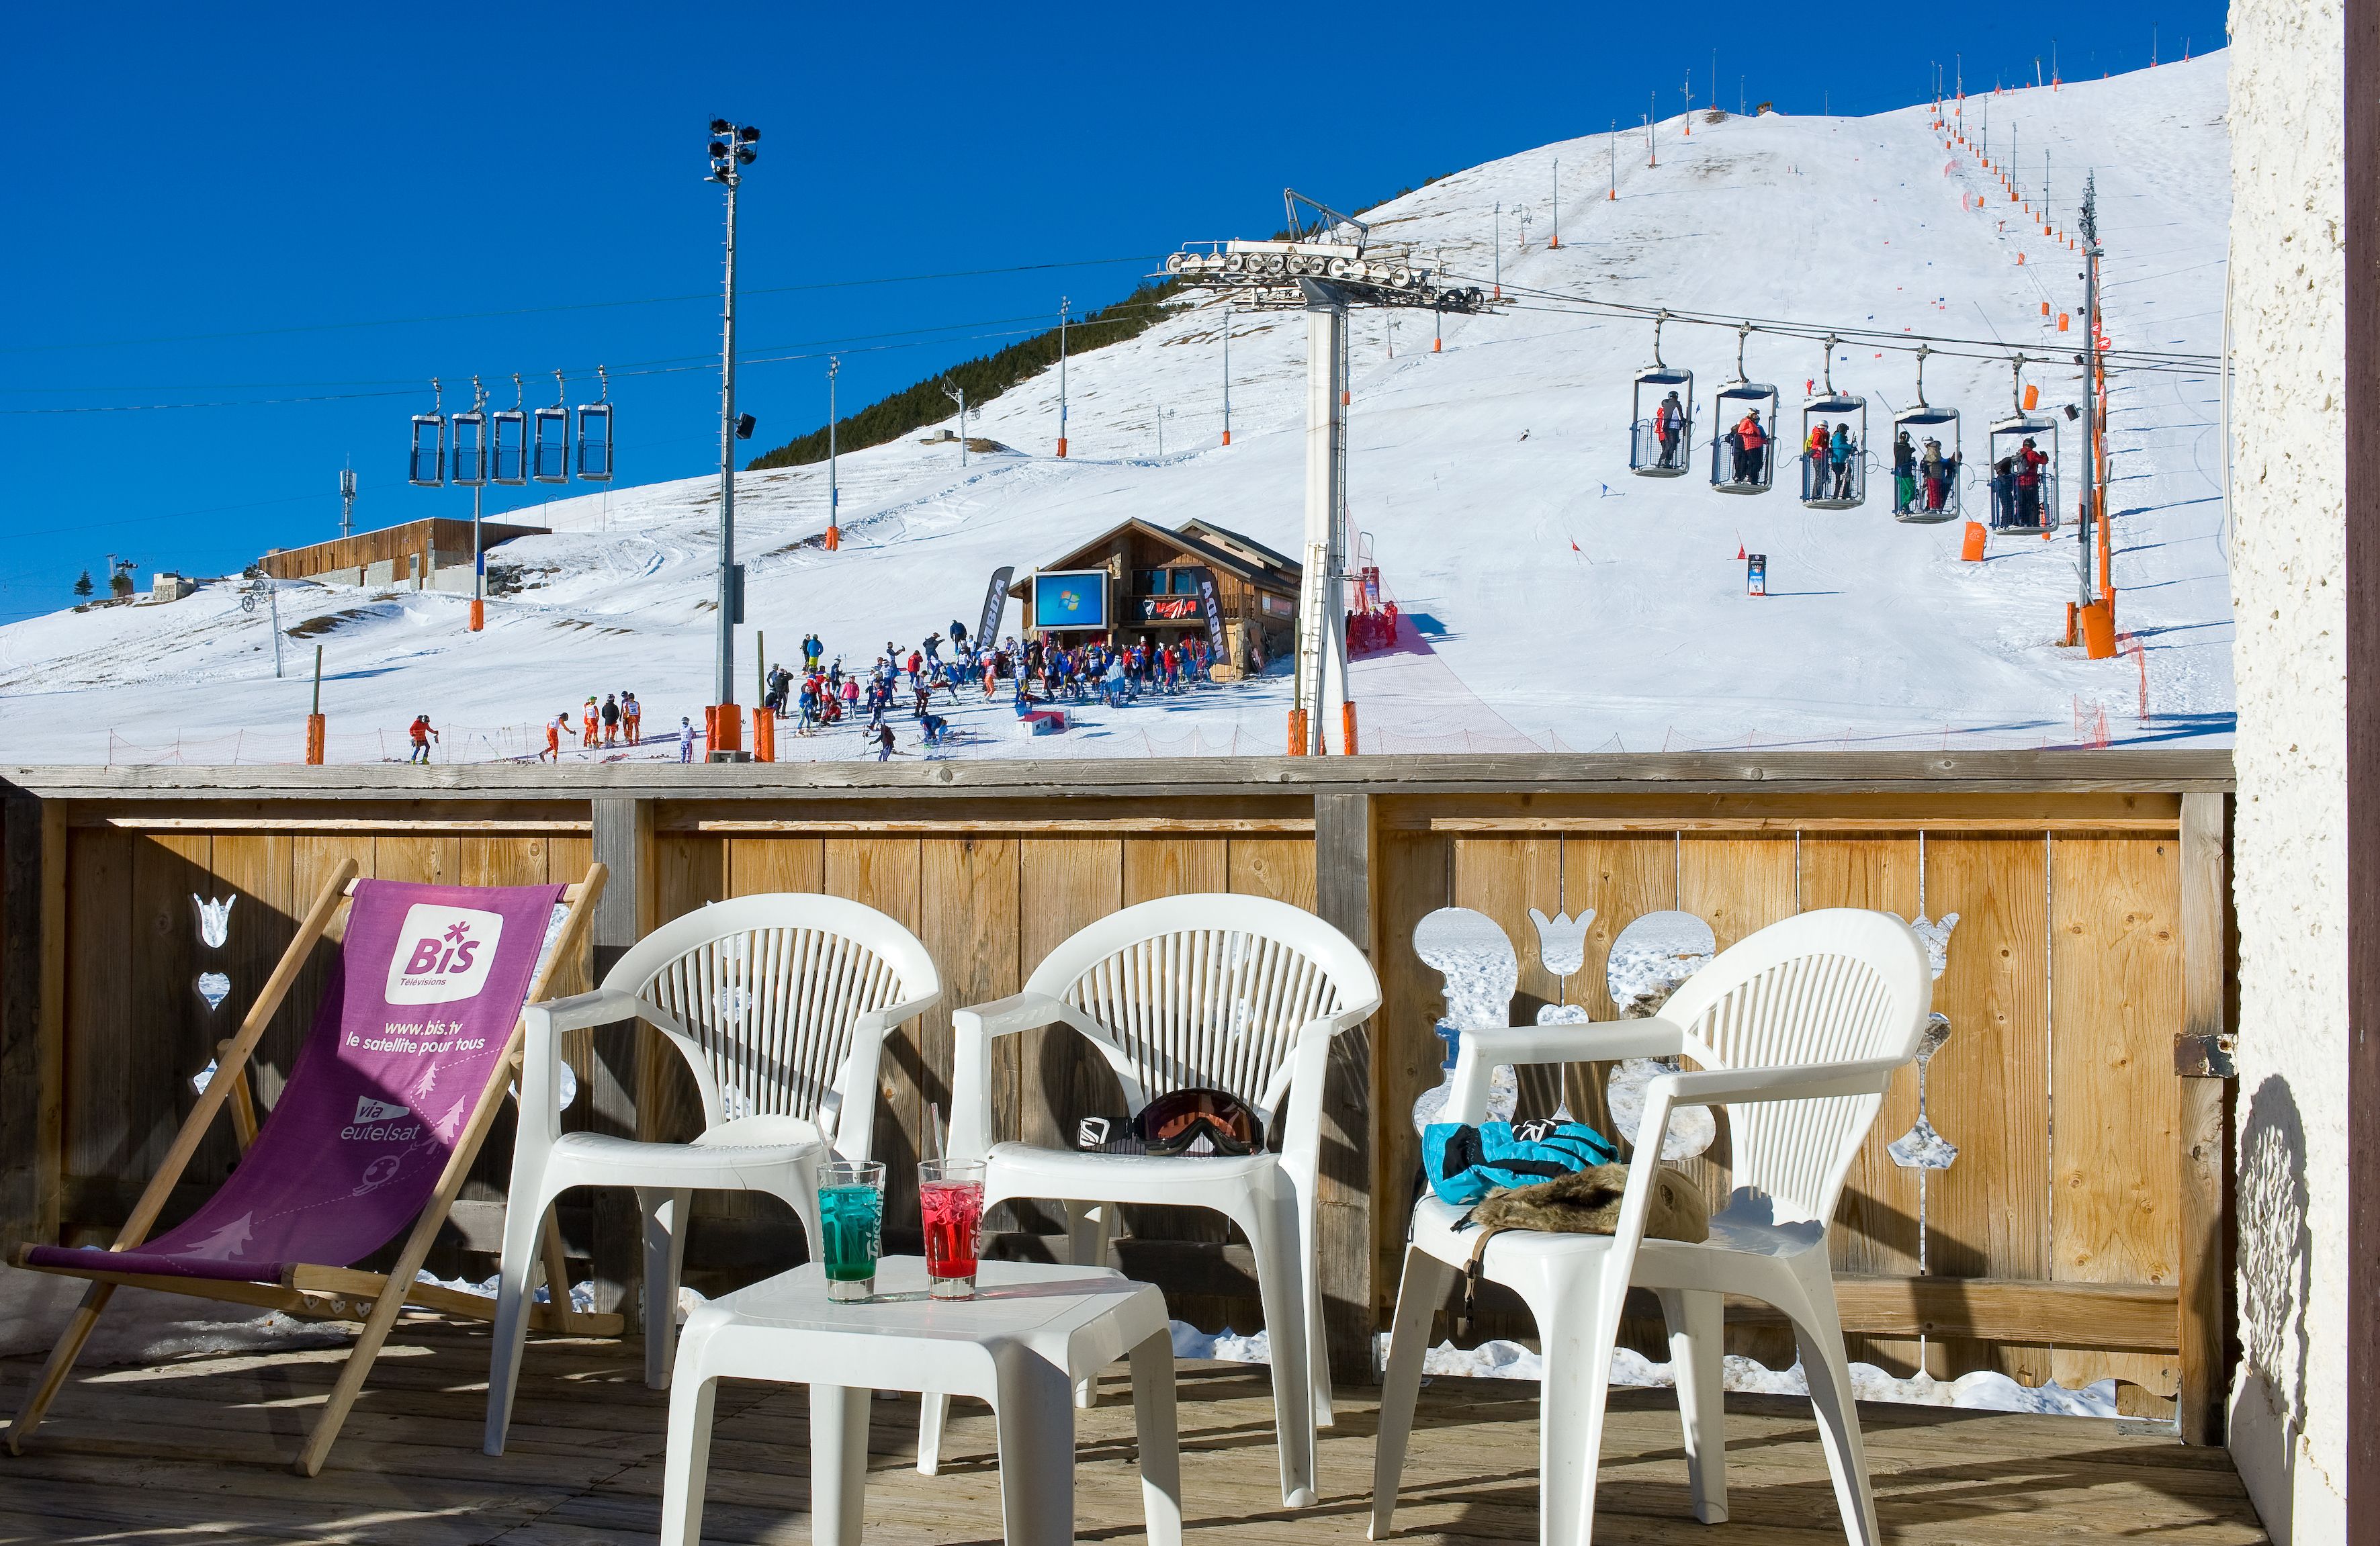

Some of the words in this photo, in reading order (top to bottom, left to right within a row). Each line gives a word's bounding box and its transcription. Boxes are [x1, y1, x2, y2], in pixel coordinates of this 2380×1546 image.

[981, 579, 1005, 646] MBDA
[1202, 581, 1224, 659] MBDA
[400, 978, 447, 986] Télévisions
[385, 1020, 463, 1036] www.bis.tv
[346, 1031, 360, 1046] le
[363, 1038, 417, 1053] satellite
[418, 1041, 453, 1056] pour
[455, 1038, 486, 1051] tous
[359, 1101, 384, 1118] via
[341, 1123, 421, 1141] eutelsat
